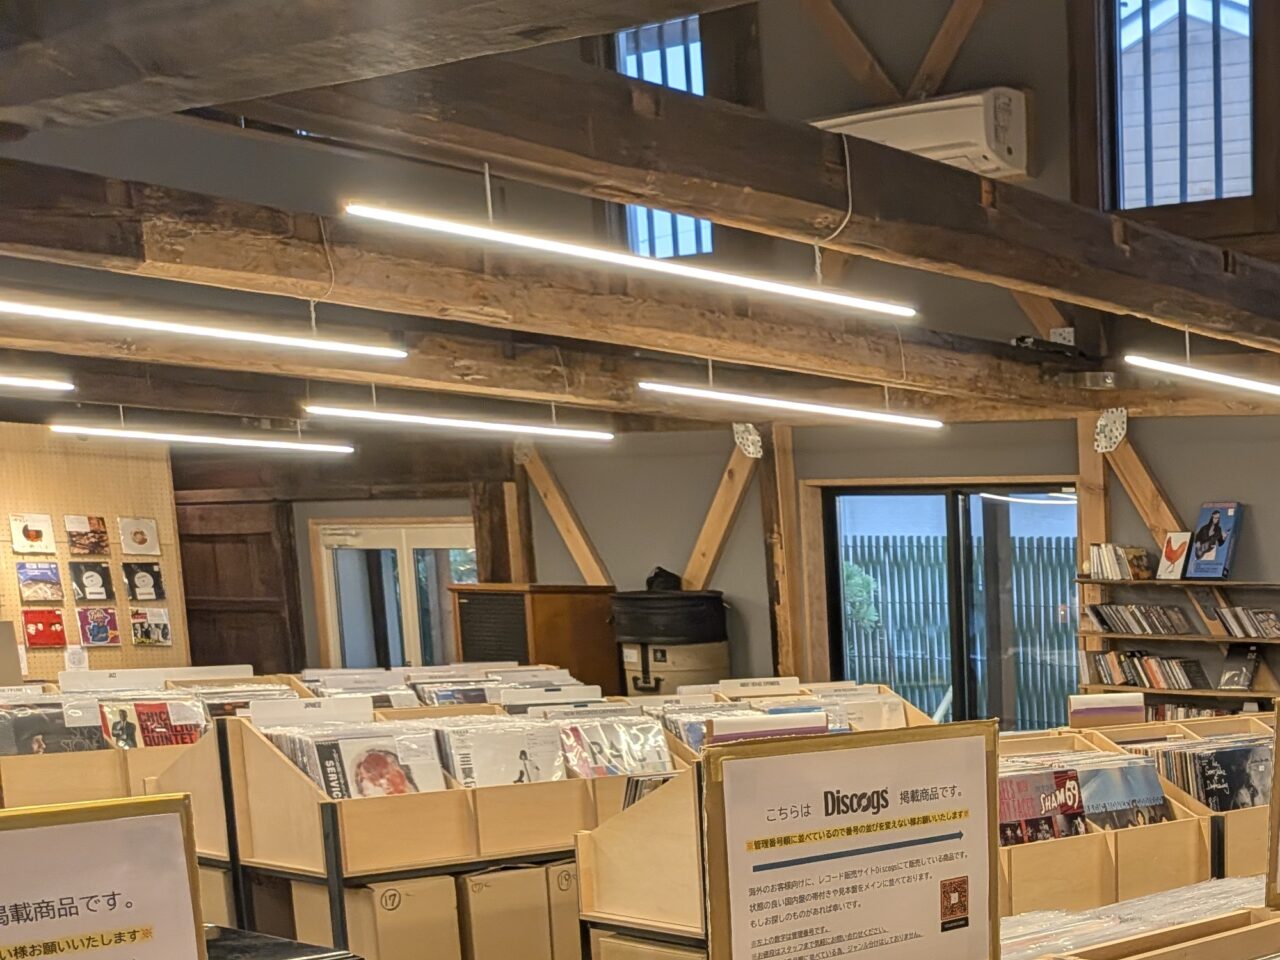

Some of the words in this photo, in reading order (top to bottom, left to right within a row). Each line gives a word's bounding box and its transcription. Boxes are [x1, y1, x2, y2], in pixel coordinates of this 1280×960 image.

[144, 733, 196, 747] QUINTET
[325, 760, 343, 799] SERVIC
[1065, 779, 1079, 810] 69
[766, 803, 812, 823] こちらは
[824, 786, 890, 817] Discogs
[900, 784, 963, 806] 掲載商品です。
